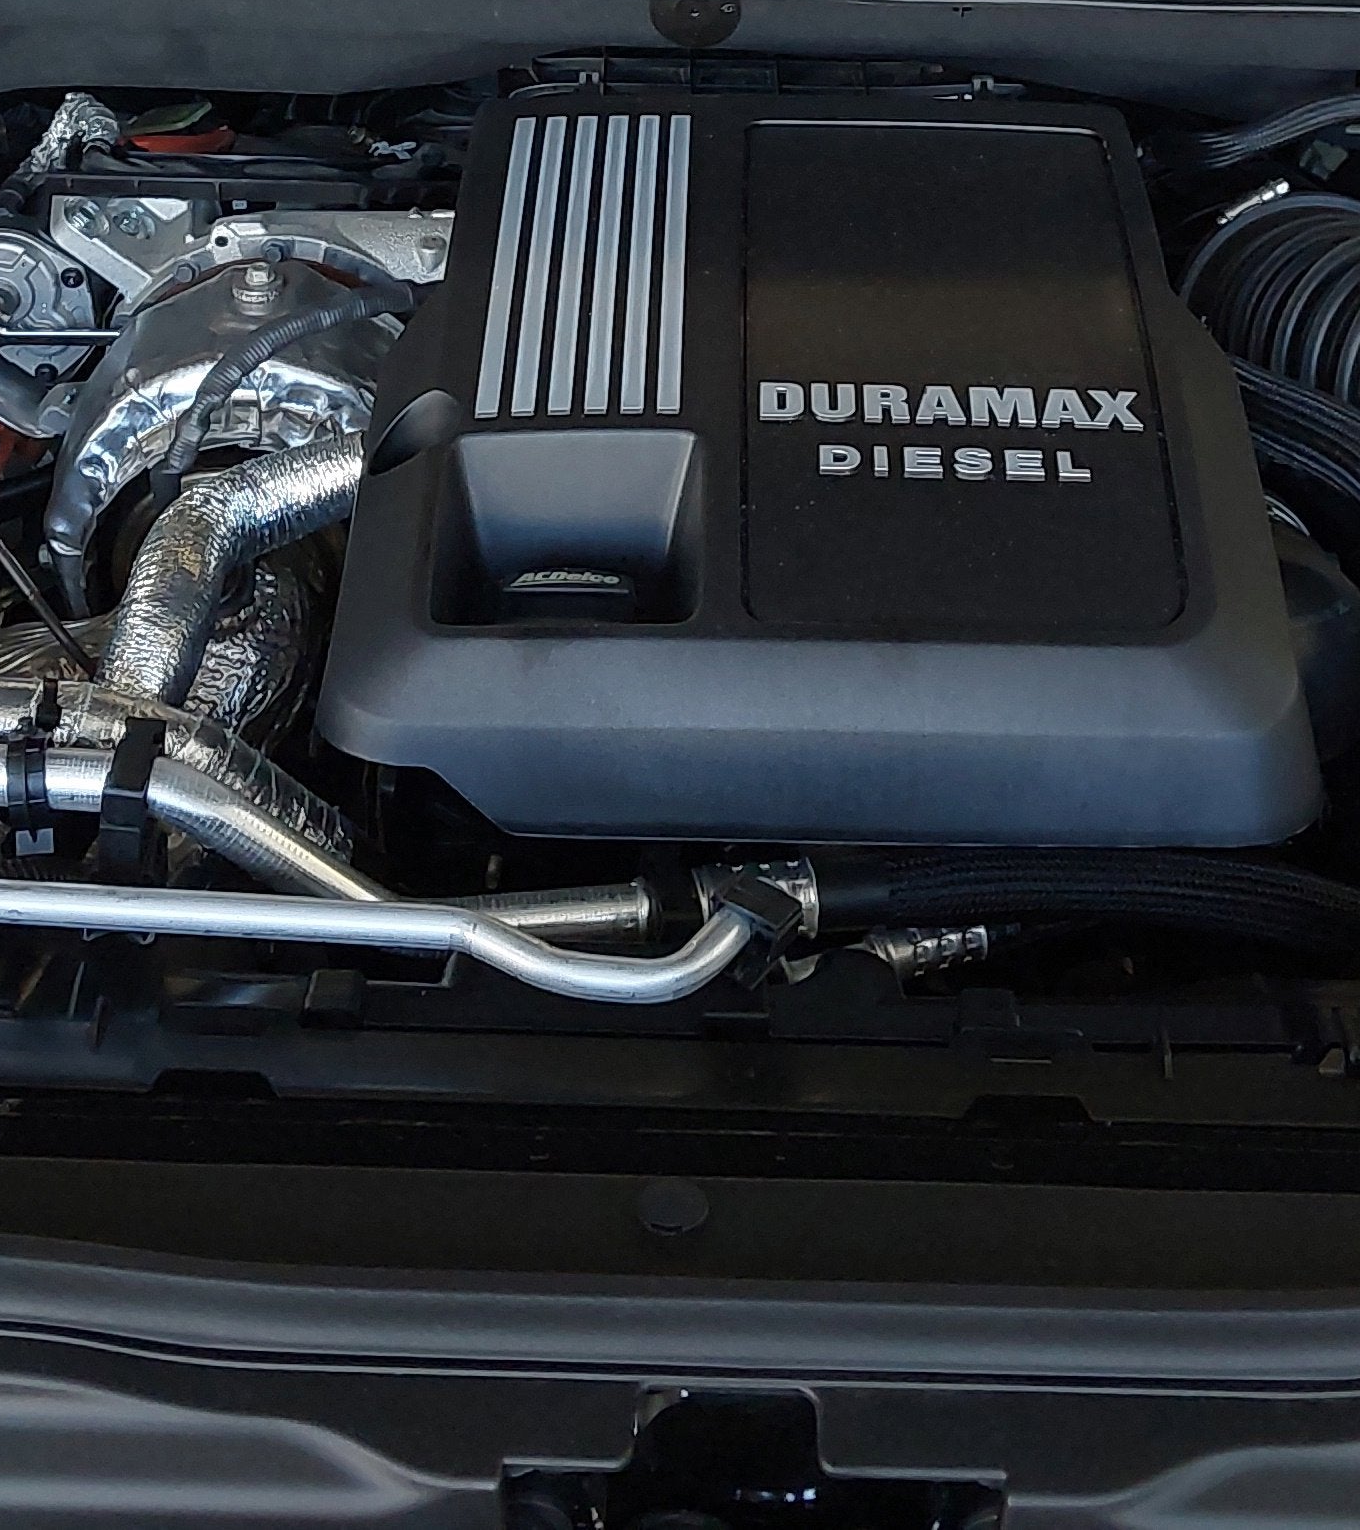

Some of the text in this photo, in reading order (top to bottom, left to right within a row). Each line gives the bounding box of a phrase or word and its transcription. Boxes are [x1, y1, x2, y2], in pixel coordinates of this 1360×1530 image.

[759, 381, 1144, 432] DURAMAX
[818, 444, 1092, 483] DIESEL
[510, 571, 620, 587] ACDelco
